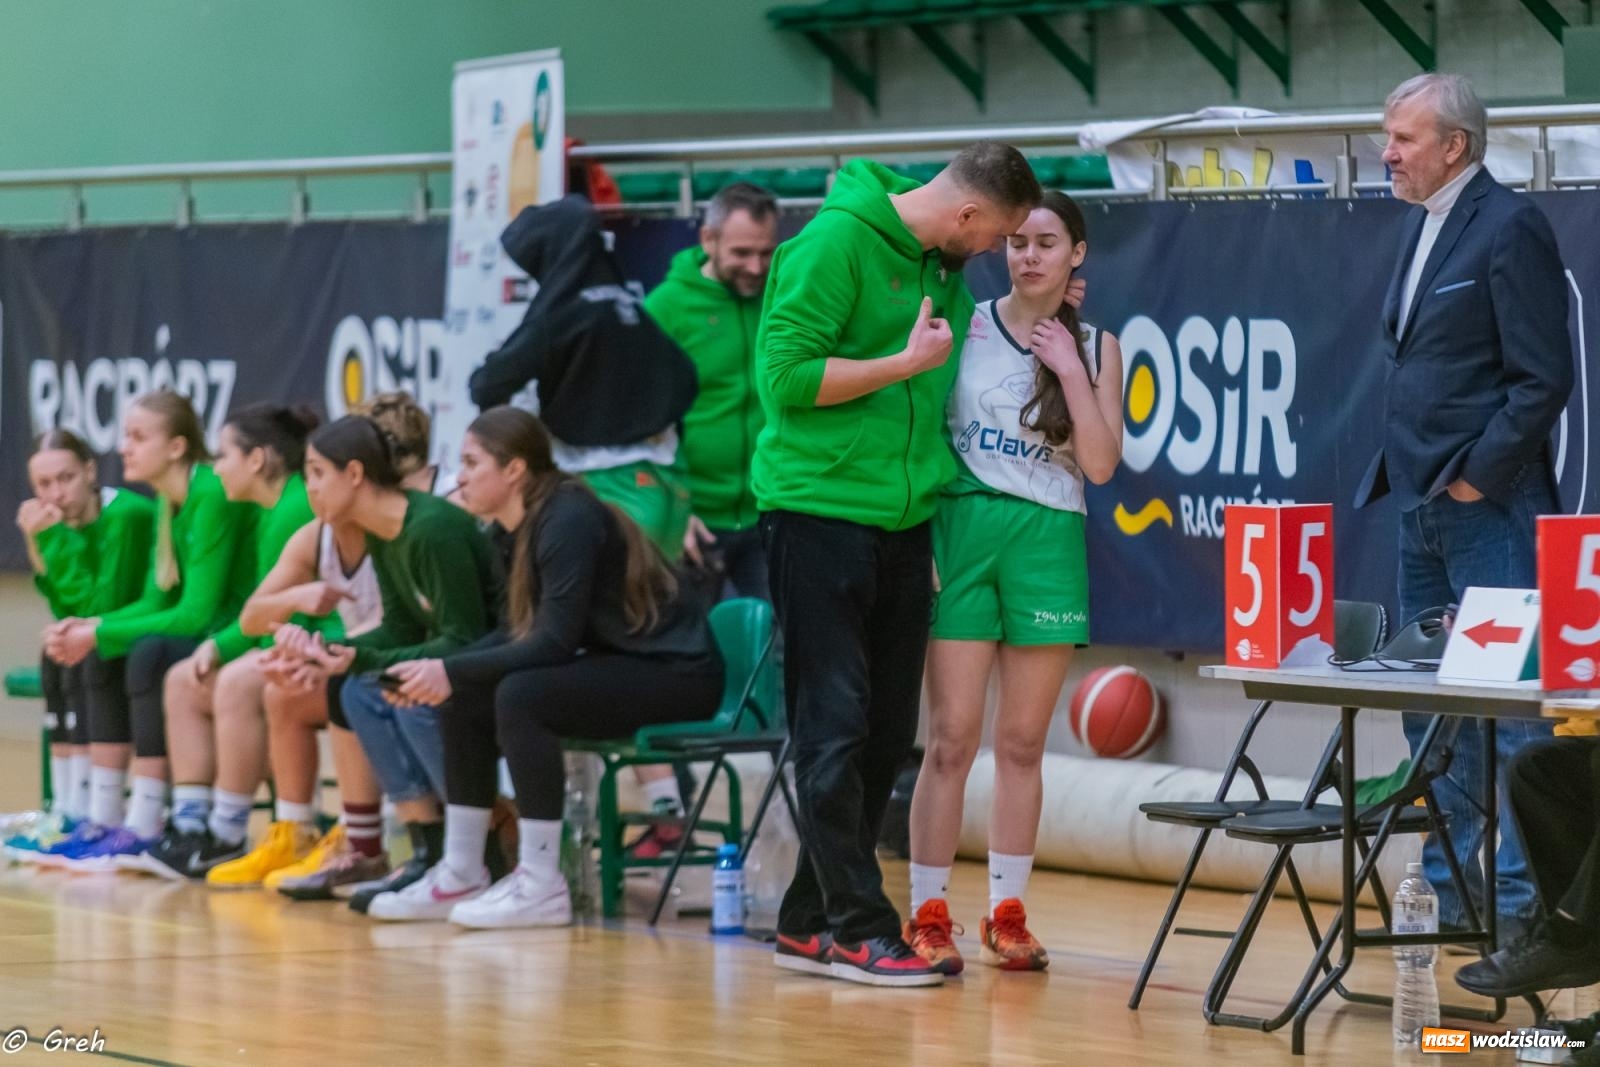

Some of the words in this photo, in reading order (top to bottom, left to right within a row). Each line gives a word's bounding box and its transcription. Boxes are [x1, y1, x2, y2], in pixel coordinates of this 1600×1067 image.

[1117, 315, 1297, 478] OSiR
[1233, 523, 1265, 627] 5
[1288, 522, 1325, 627] 5
